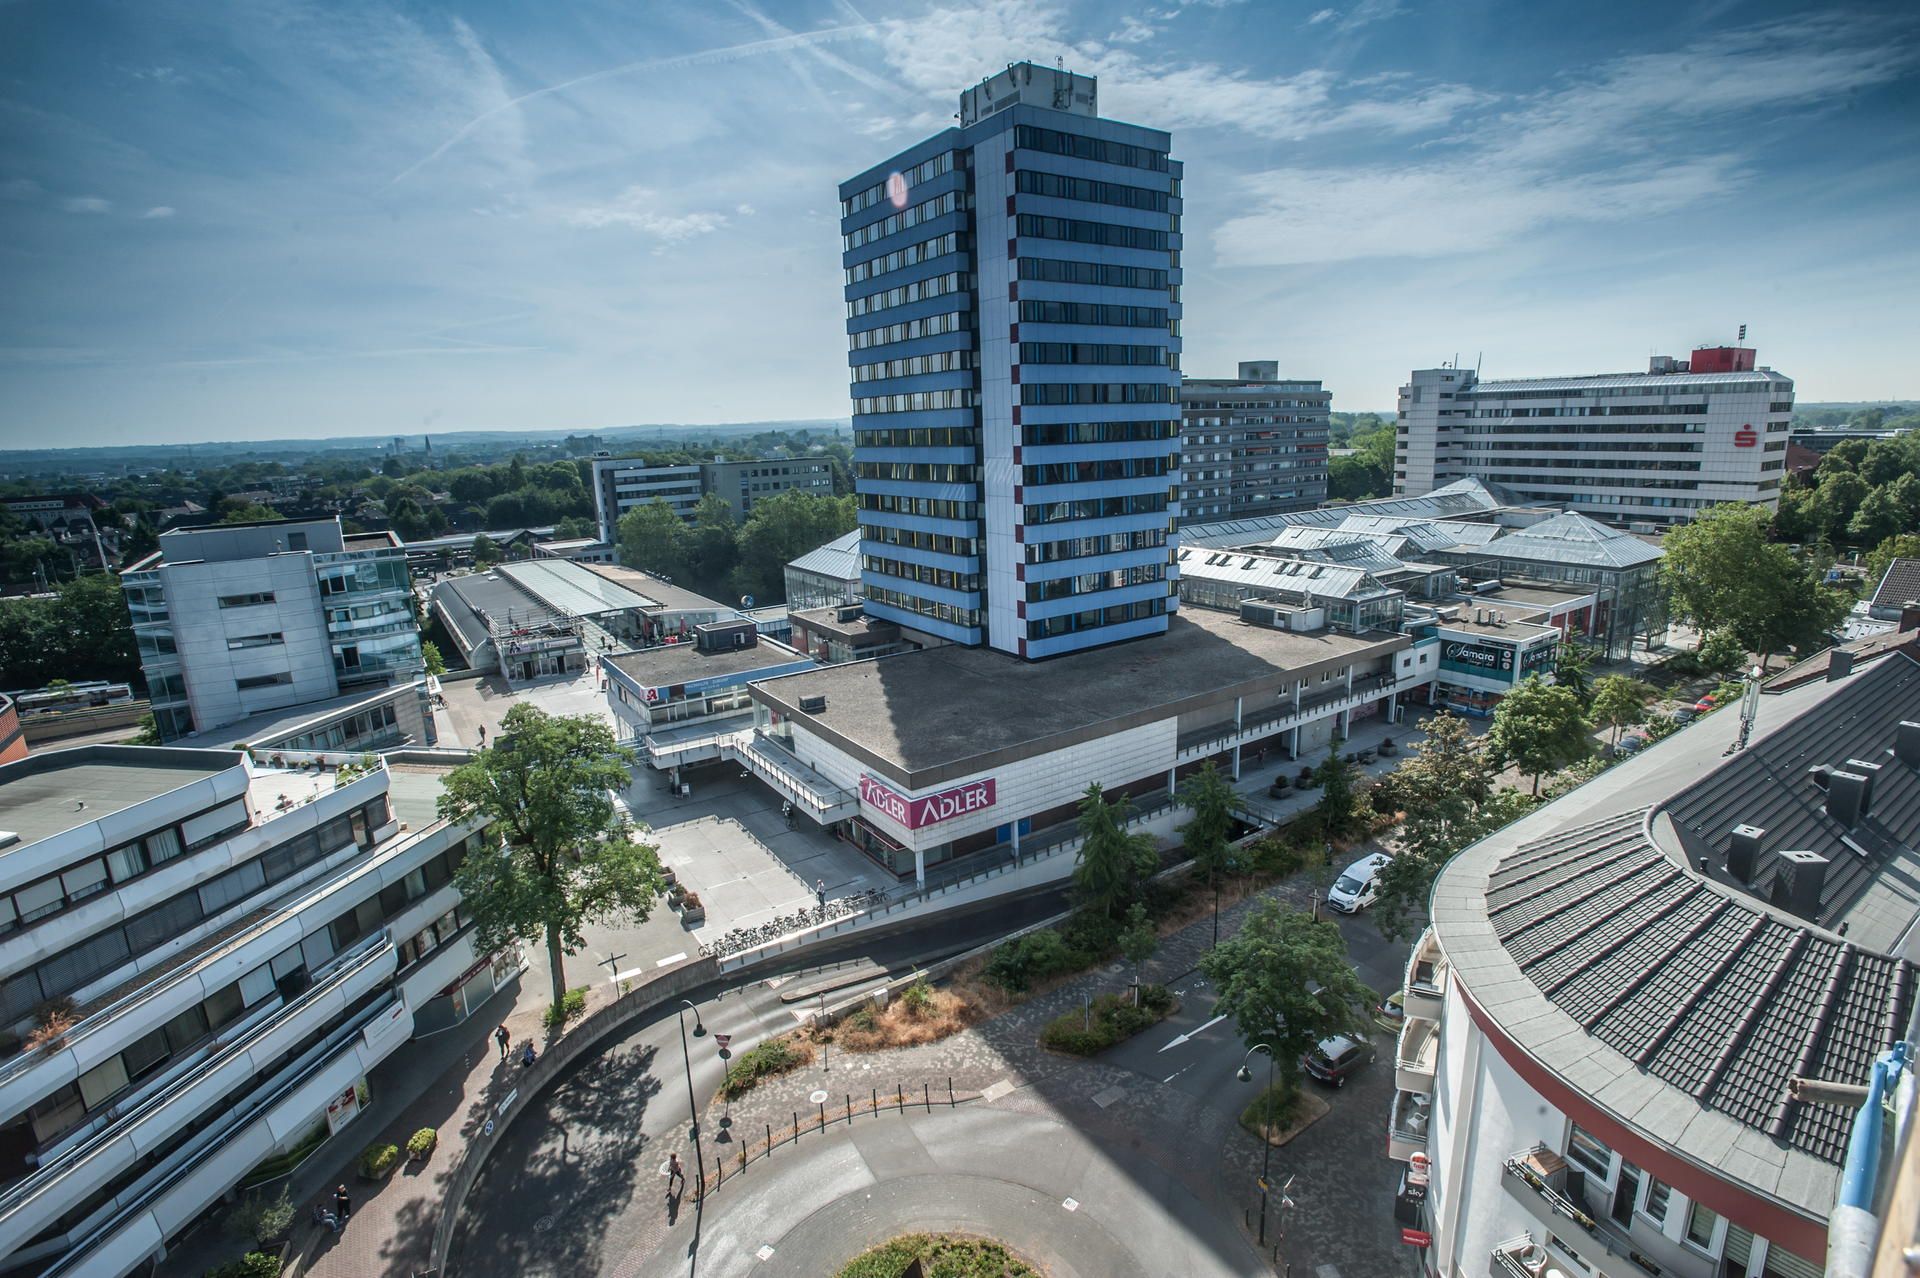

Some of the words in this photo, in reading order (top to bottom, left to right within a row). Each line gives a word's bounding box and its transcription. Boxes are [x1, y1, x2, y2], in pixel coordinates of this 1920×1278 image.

[1446, 642, 1495, 662] Samara
[866, 780, 906, 824] ADLER
[919, 787, 989, 827] ADLER
[1408, 1188, 1424, 1198] sky
